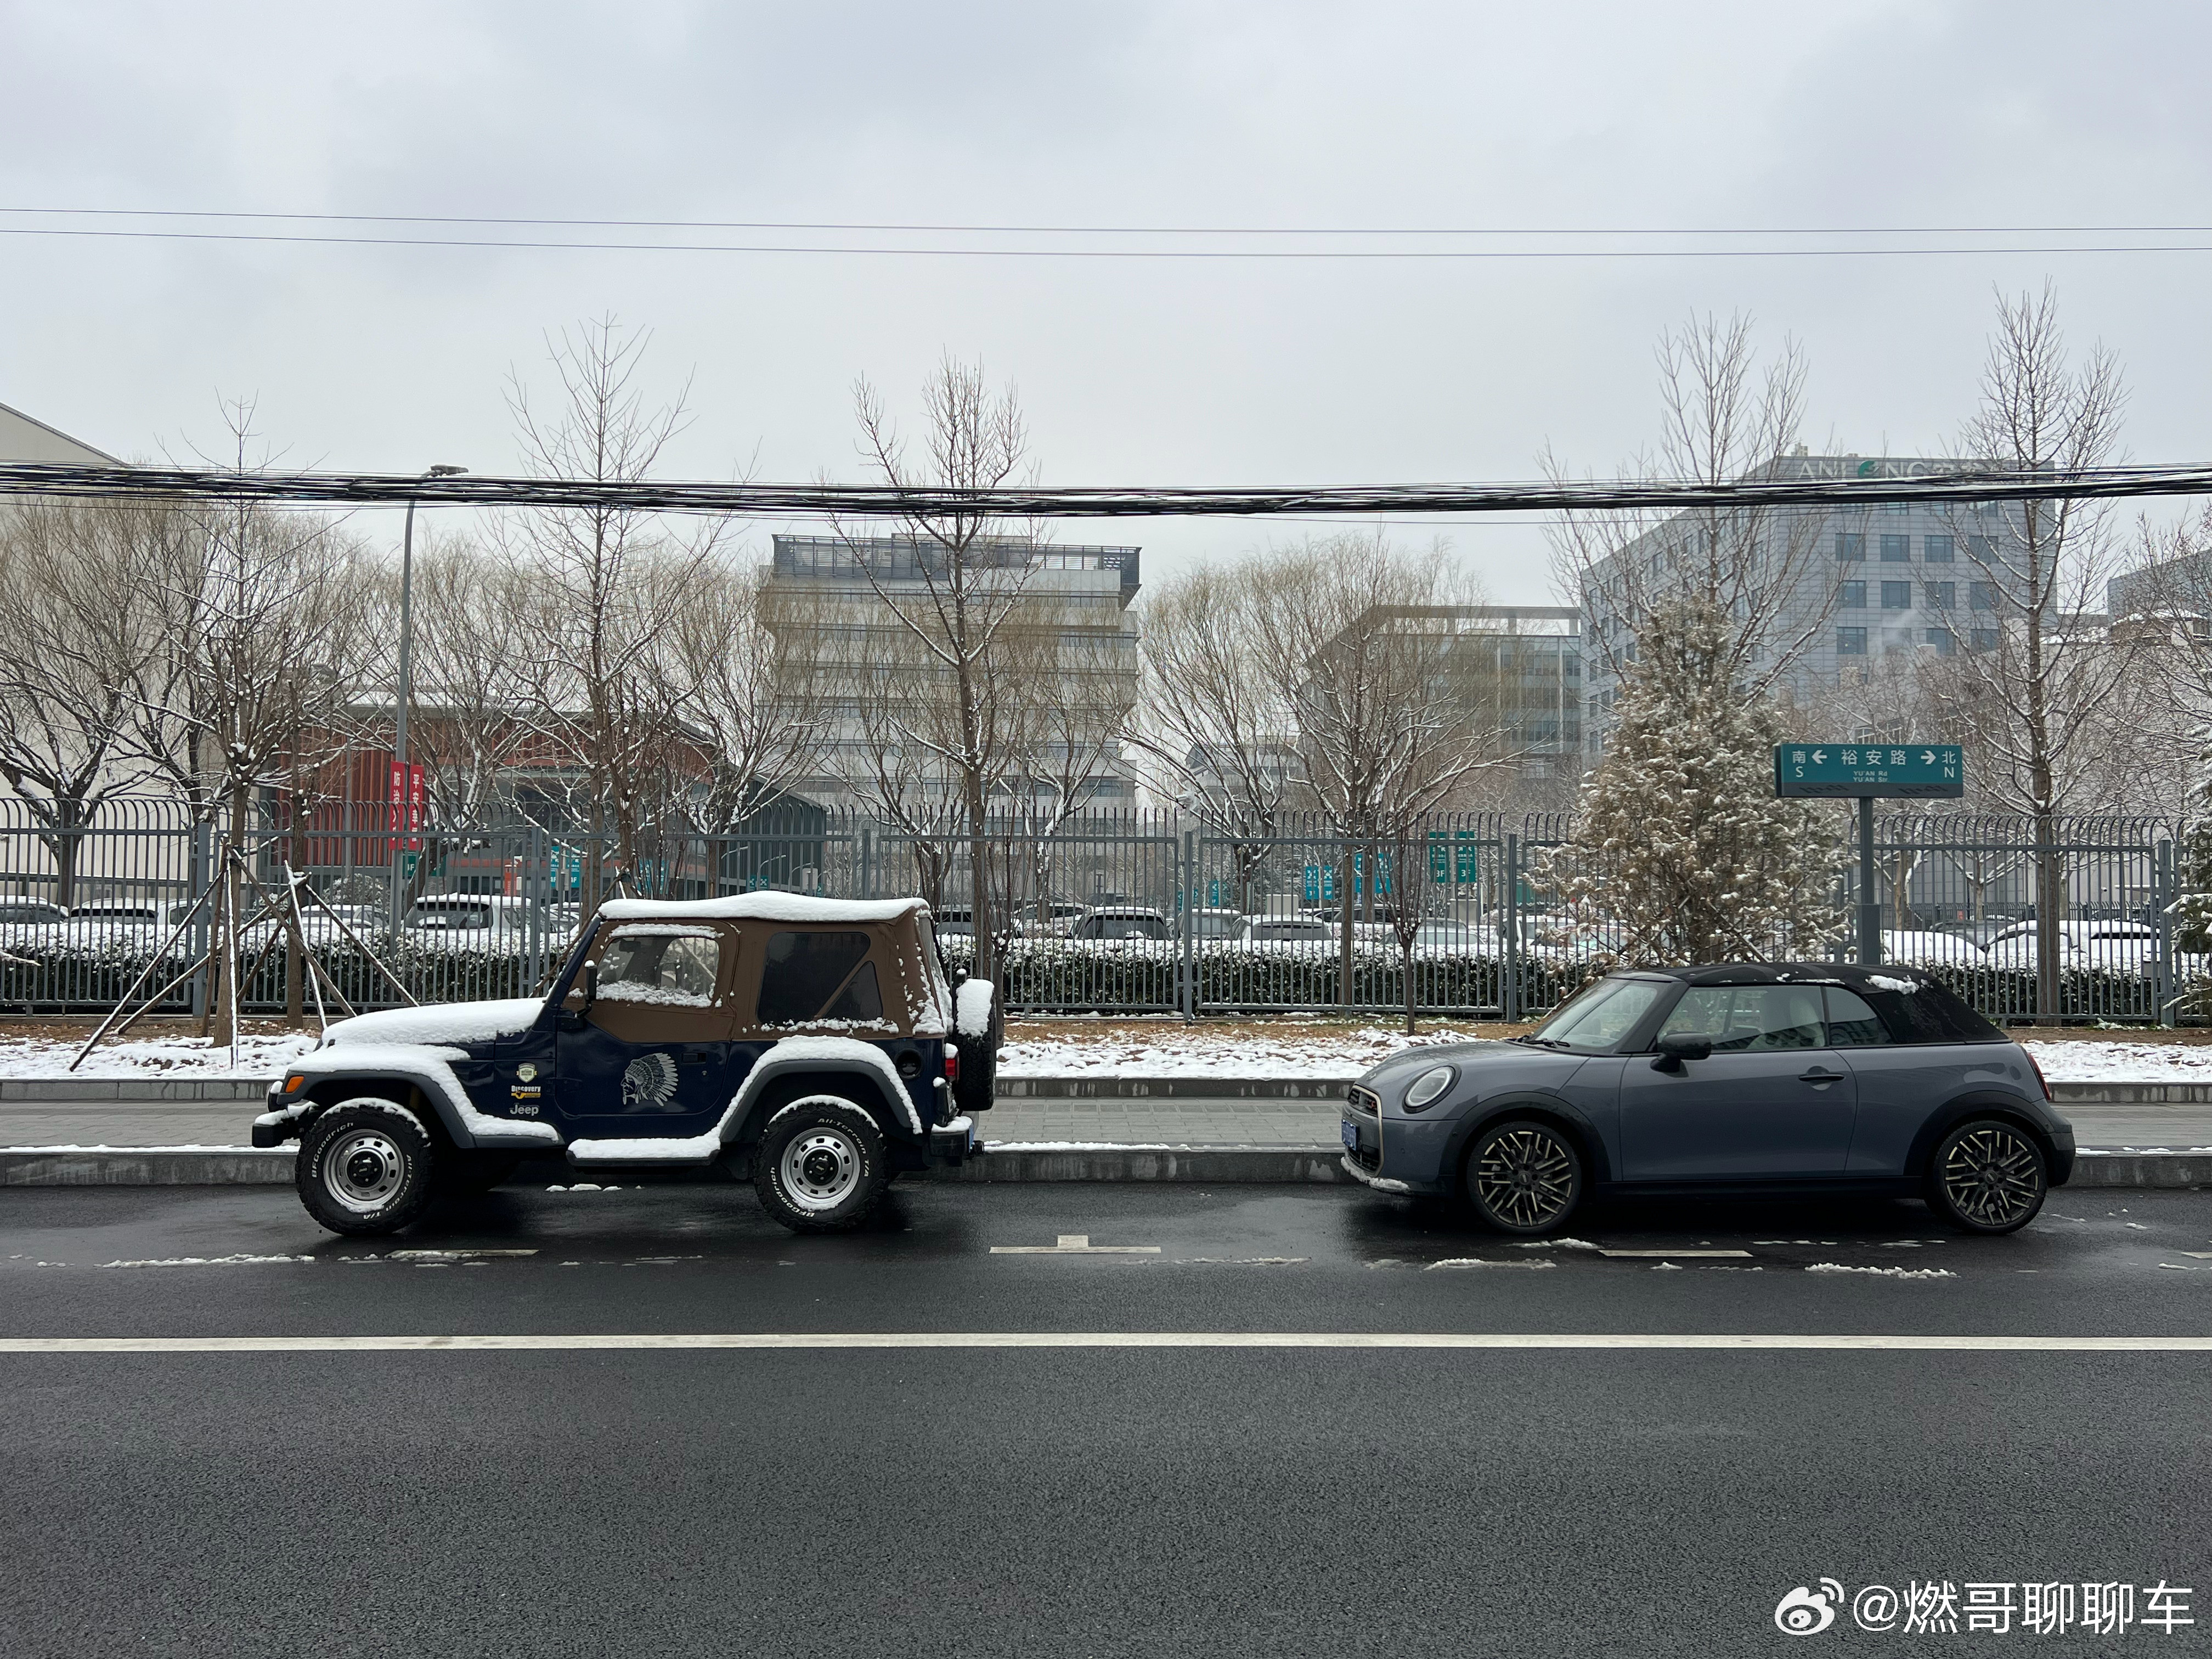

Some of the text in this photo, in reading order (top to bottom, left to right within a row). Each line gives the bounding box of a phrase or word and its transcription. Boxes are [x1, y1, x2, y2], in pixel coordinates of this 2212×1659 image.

[1792, 750, 1806, 764] 南
[1841, 749, 1906, 765] 裕安路
[1942, 751, 1956, 764] 北
[1796, 766, 1803, 777] S
[1944, 767, 1954, 778] N
[510, 1104, 539, 1116] Jeep
[817, 1118, 867, 1154] All-Terrain
[312, 1122, 354, 1178] BFGoodrich
[363, 1154, 413, 1220] All-Terrain T/A
[770, 1166, 815, 1217] BFGoodrich
